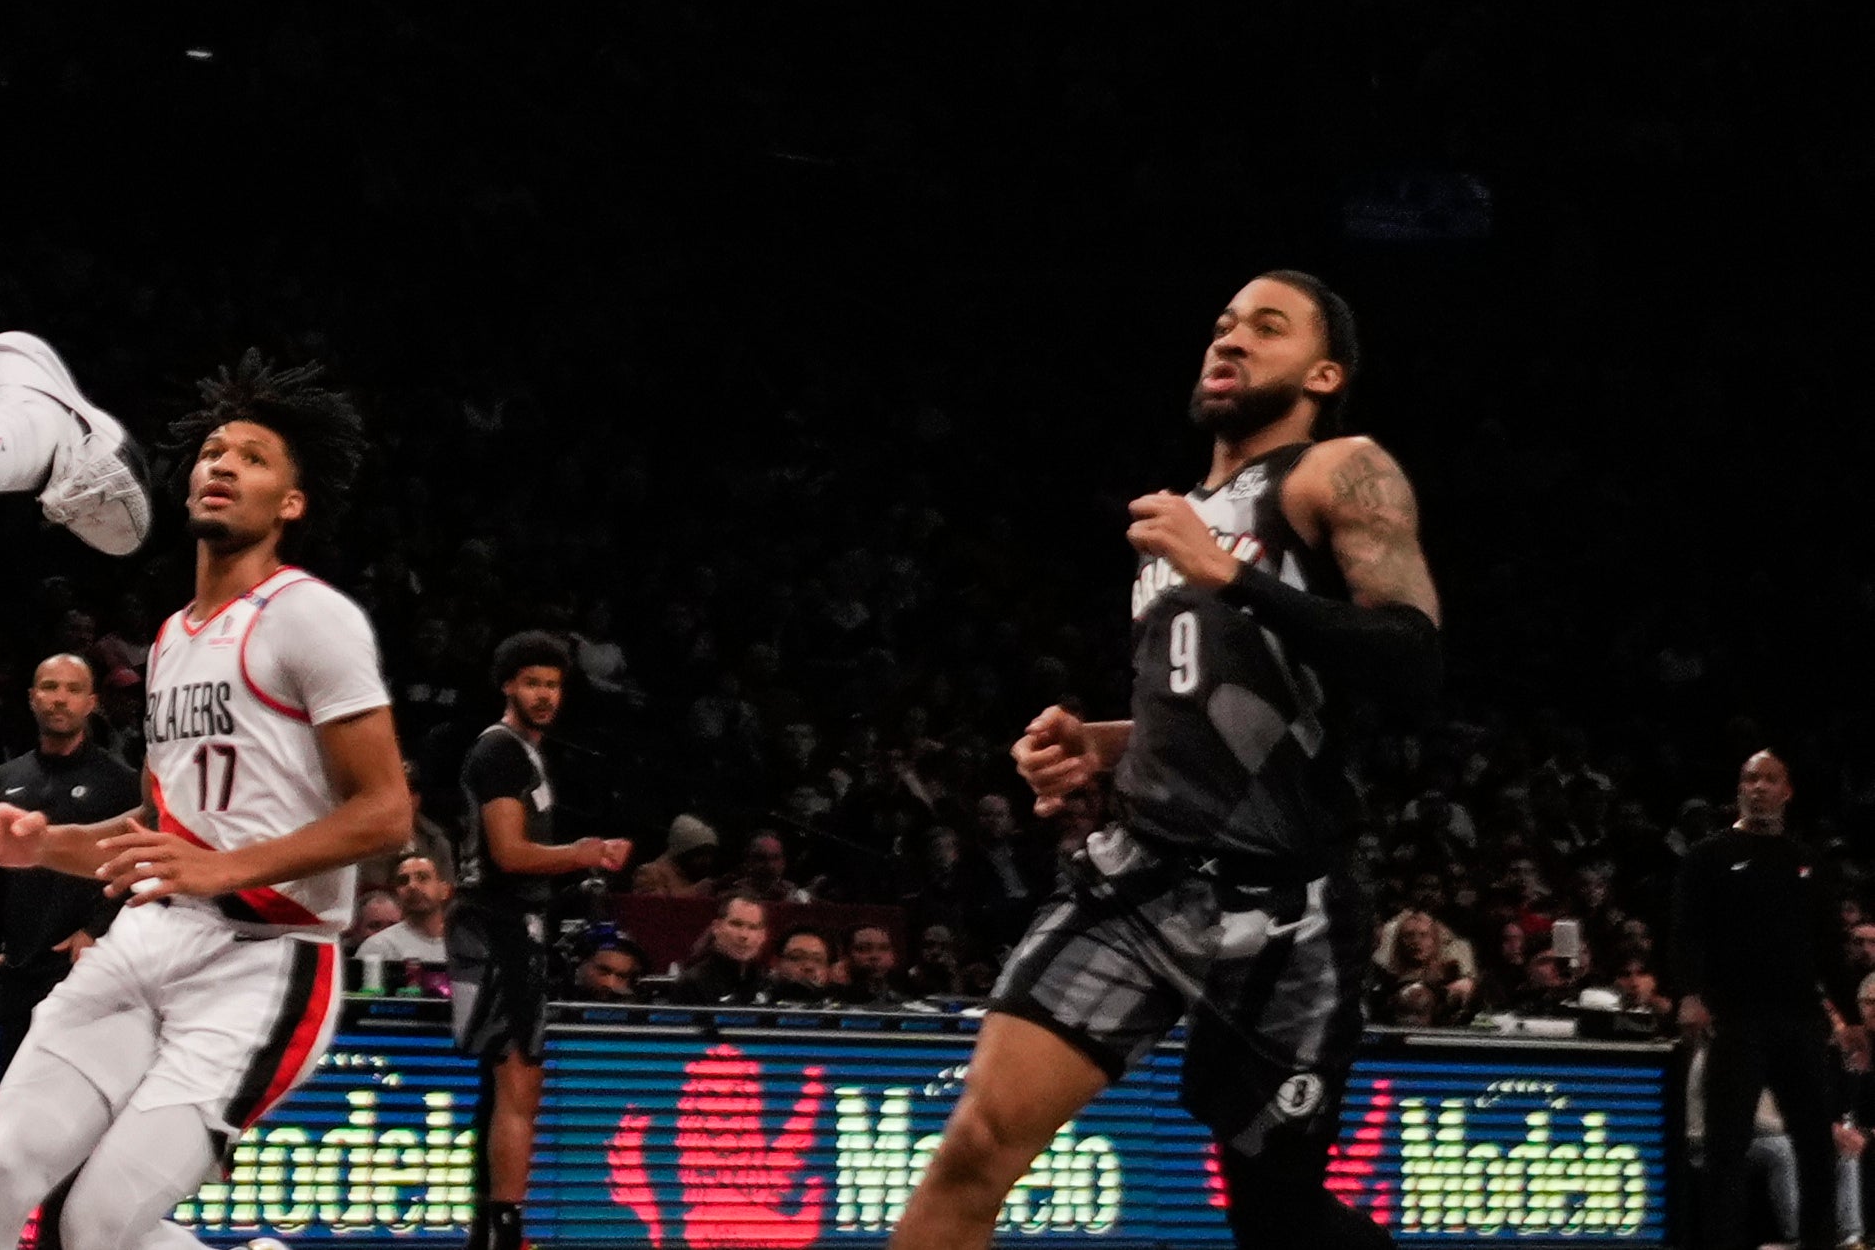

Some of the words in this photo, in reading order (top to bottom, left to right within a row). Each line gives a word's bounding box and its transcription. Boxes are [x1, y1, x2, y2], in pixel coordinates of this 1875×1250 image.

[1169, 612, 1199, 695] 9
[193, 743, 236, 812] 17
[1399, 1099, 1645, 1235] Modelo
